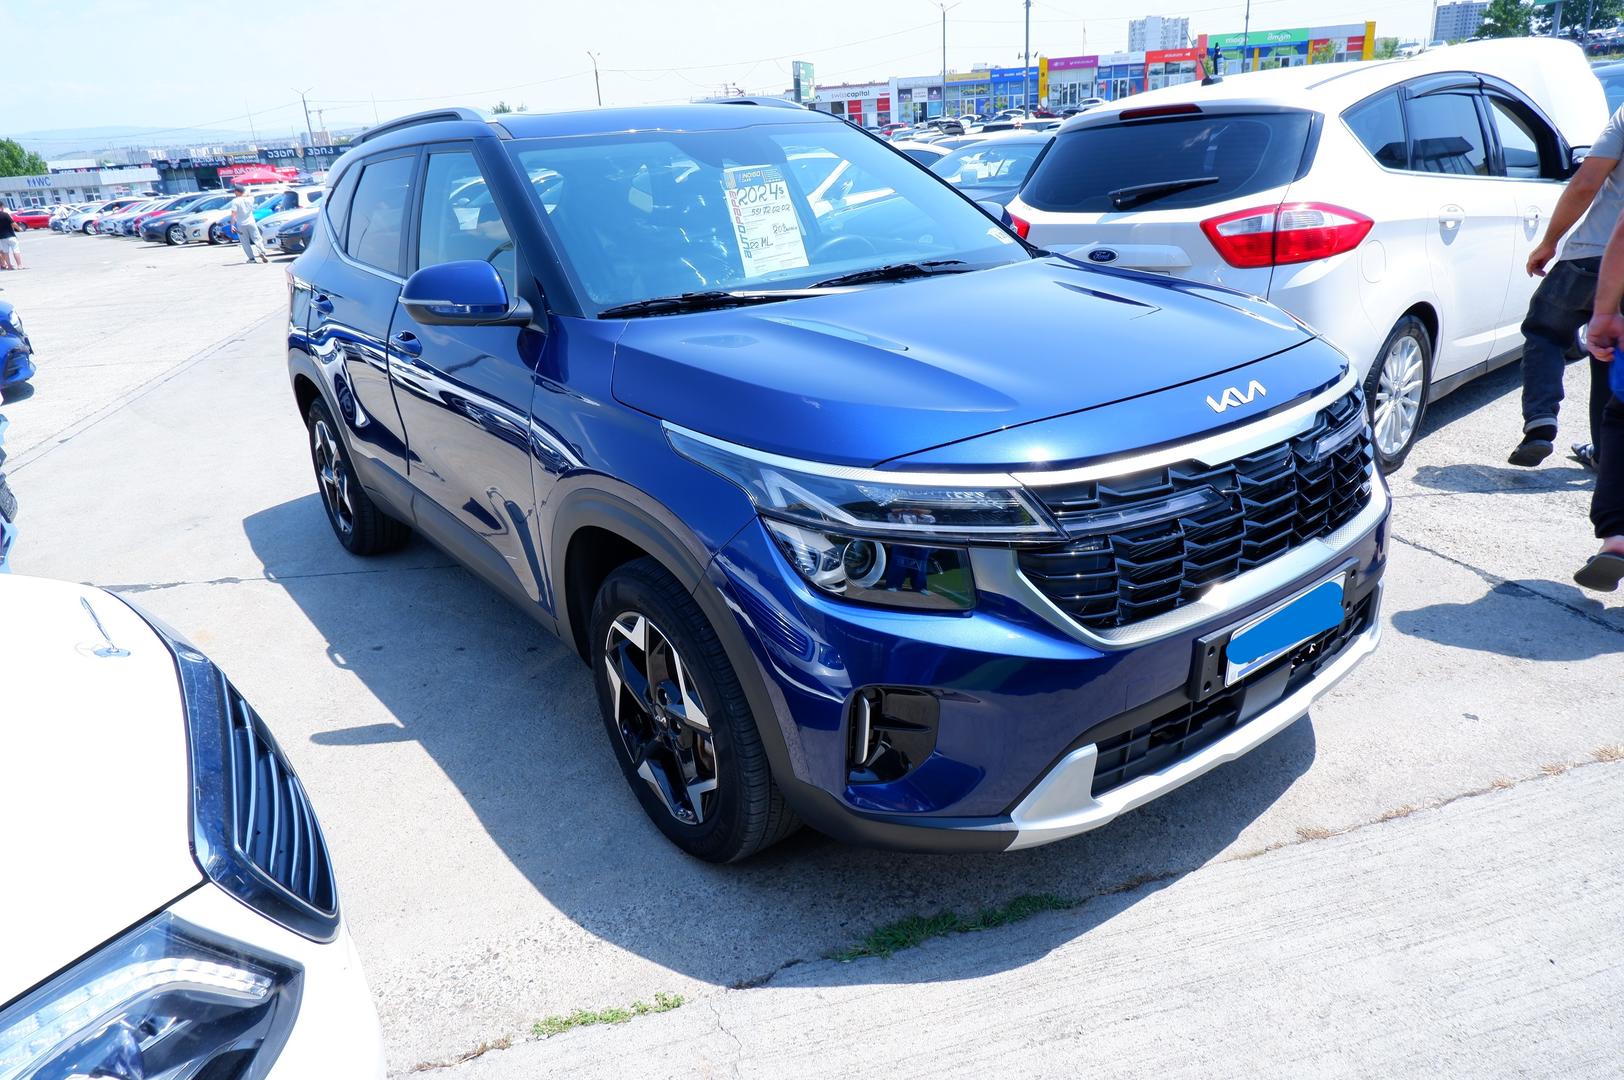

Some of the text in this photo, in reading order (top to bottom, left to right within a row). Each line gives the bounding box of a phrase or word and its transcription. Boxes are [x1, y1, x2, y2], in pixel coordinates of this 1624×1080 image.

[35, 177, 52, 187] WC
[736, 184, 779, 206] 2024
[1093, 251, 1111, 260] Ford
[1206, 380, 1267, 414] KIA
